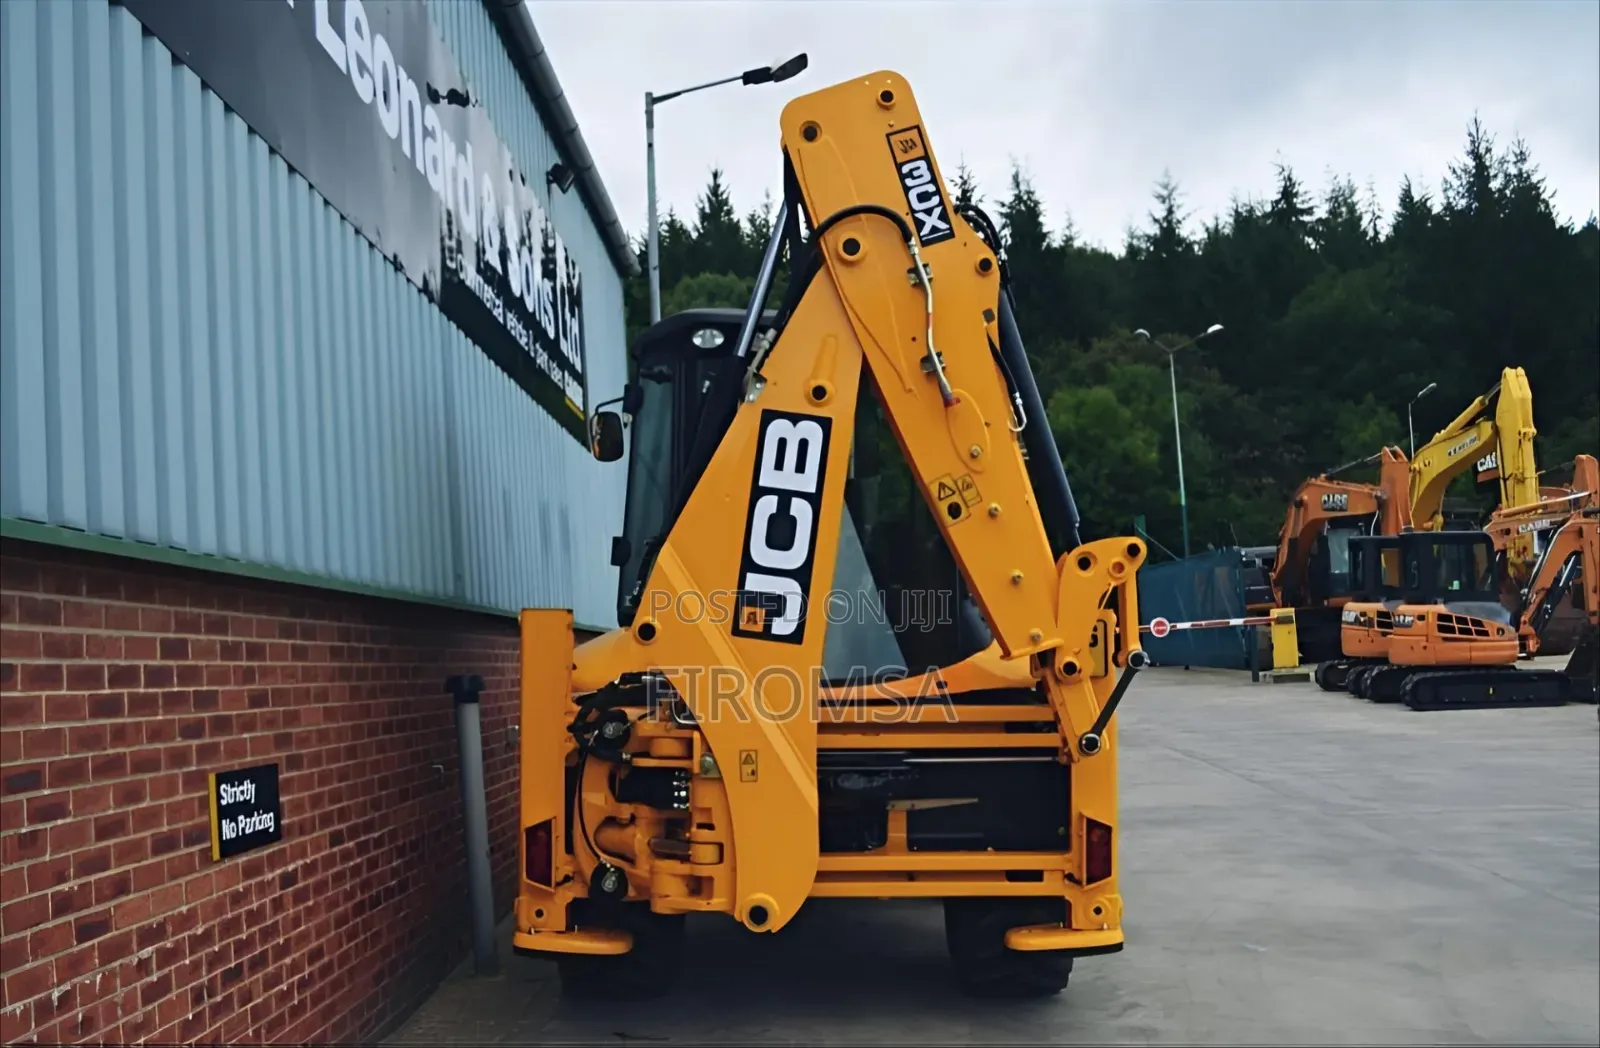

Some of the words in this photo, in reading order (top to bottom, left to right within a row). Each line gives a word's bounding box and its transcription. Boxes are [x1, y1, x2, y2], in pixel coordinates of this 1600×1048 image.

[315, 0, 476, 243] Leonard
[504, 203, 555, 340] Sons
[555, 231, 582, 374] Ltd
[901, 159, 951, 237] 3CX
[744, 417, 824, 636] JCB
[219, 779, 256, 806] Strictly
[221, 818, 238, 841] No
[237, 809, 275, 836] Parking
